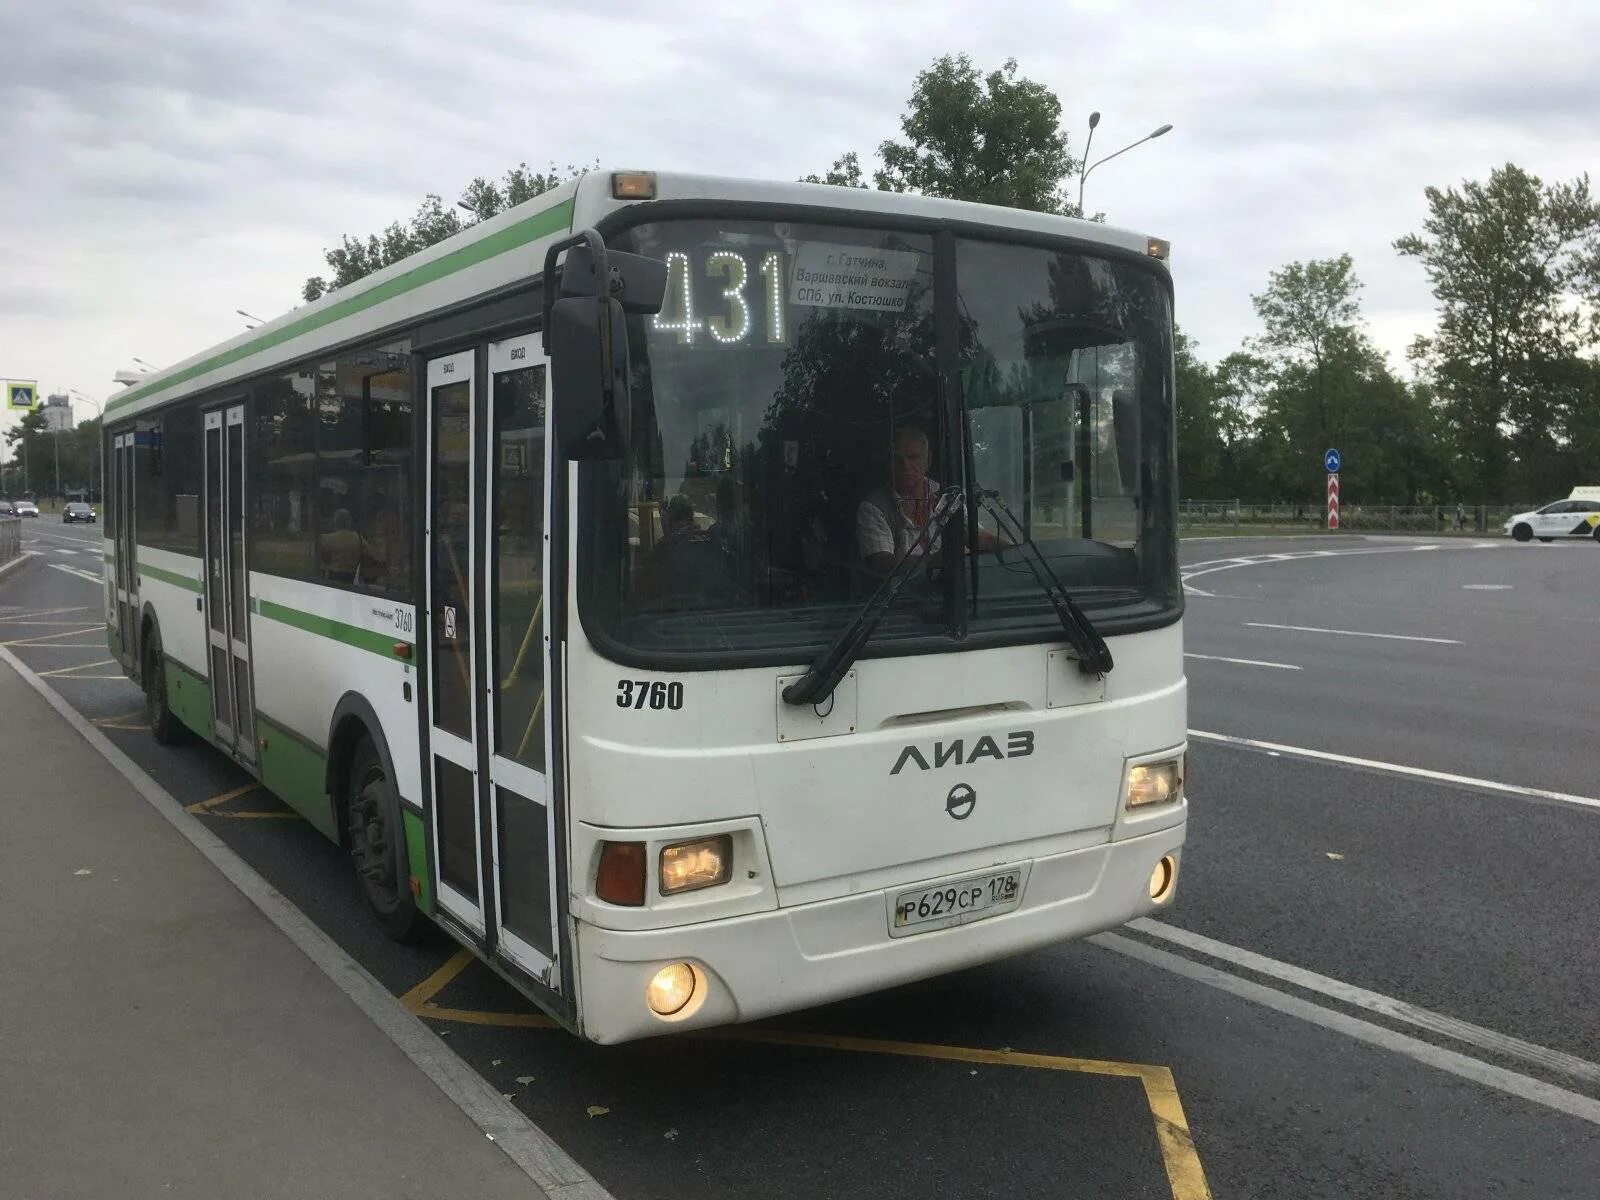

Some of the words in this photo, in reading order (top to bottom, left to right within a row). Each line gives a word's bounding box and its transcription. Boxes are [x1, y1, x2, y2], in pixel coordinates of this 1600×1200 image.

[797, 269, 868, 287] Варшавский
[871, 275, 909, 290] вокзал
[653, 251, 786, 344] 431
[798, 288, 824, 304] СПб,
[829, 292, 845, 305] ул.
[849, 291, 904, 307] Костюшко
[395, 608, 412, 632] 3760
[616, 680, 684, 710] 3760
[889, 730, 1035, 775] ЛИАЗ
[988, 876, 1014, 895] 178
